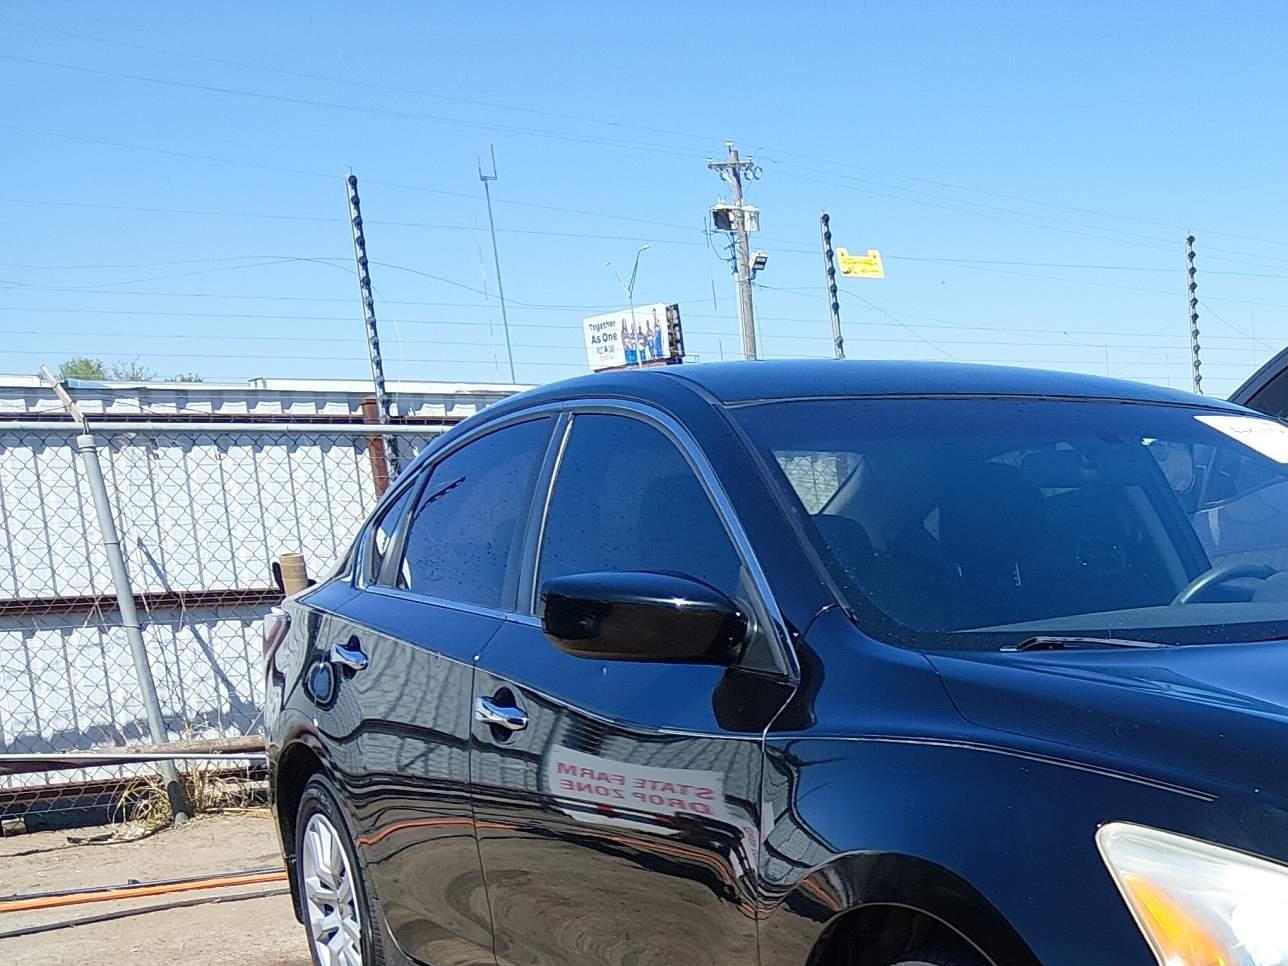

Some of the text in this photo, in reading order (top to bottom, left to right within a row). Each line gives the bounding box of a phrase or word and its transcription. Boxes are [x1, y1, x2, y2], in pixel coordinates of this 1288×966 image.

[588, 320, 616, 332] Together
[591, 332, 618, 345] As One
